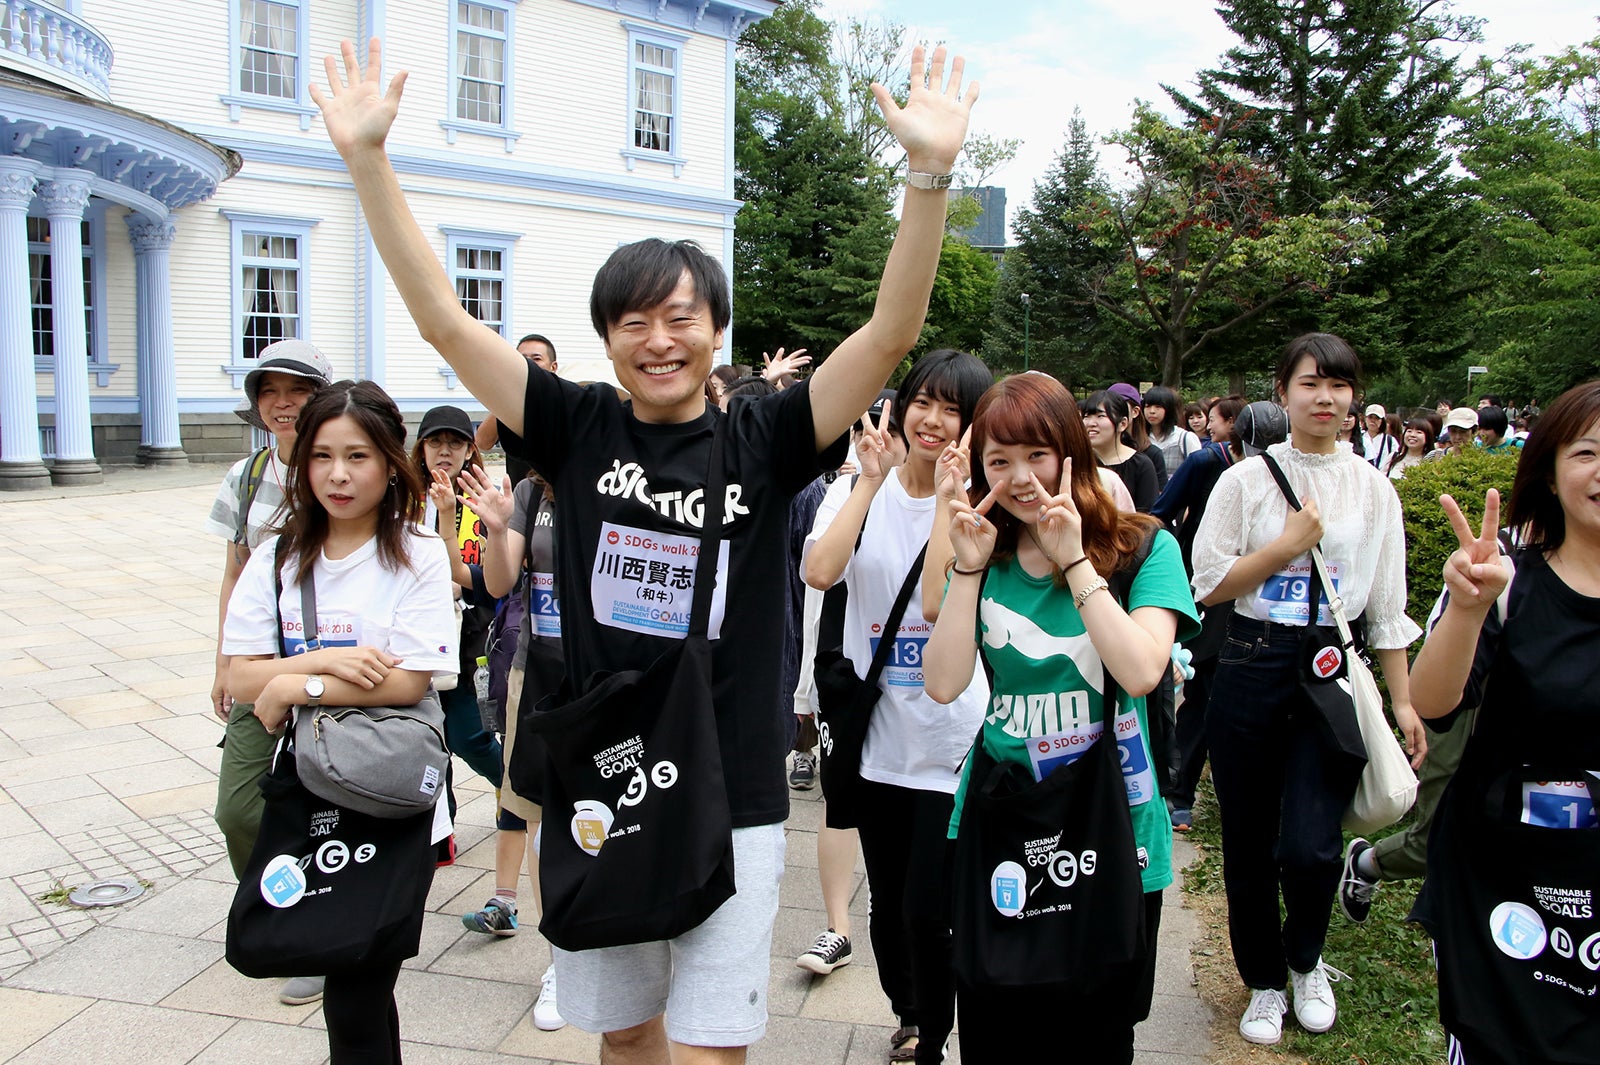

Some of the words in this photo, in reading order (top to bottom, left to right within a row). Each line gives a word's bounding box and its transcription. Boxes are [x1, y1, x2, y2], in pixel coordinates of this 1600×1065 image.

[624, 535, 658, 551] SDGs
[662, 543, 688, 556] walk
[598, 551, 696, 590] 川西賢志
[538, 577, 553, 586] SDG
[331, 623, 353, 633] 2018
[907, 623, 930, 632] walk
[986, 690, 1090, 738] PUMA
[593, 735, 642, 762] SUSTAINABLE
[1053, 735, 1086, 750] SDGs
[596, 742, 644, 768] DEVELOPMENT
[1533, 885, 1592, 898] SUSTAINABLE
[1535, 893, 1592, 905] DEVELOPMENT
[1539, 899, 1594, 919] GOALS
[1545, 974, 1567, 987] SDGs
